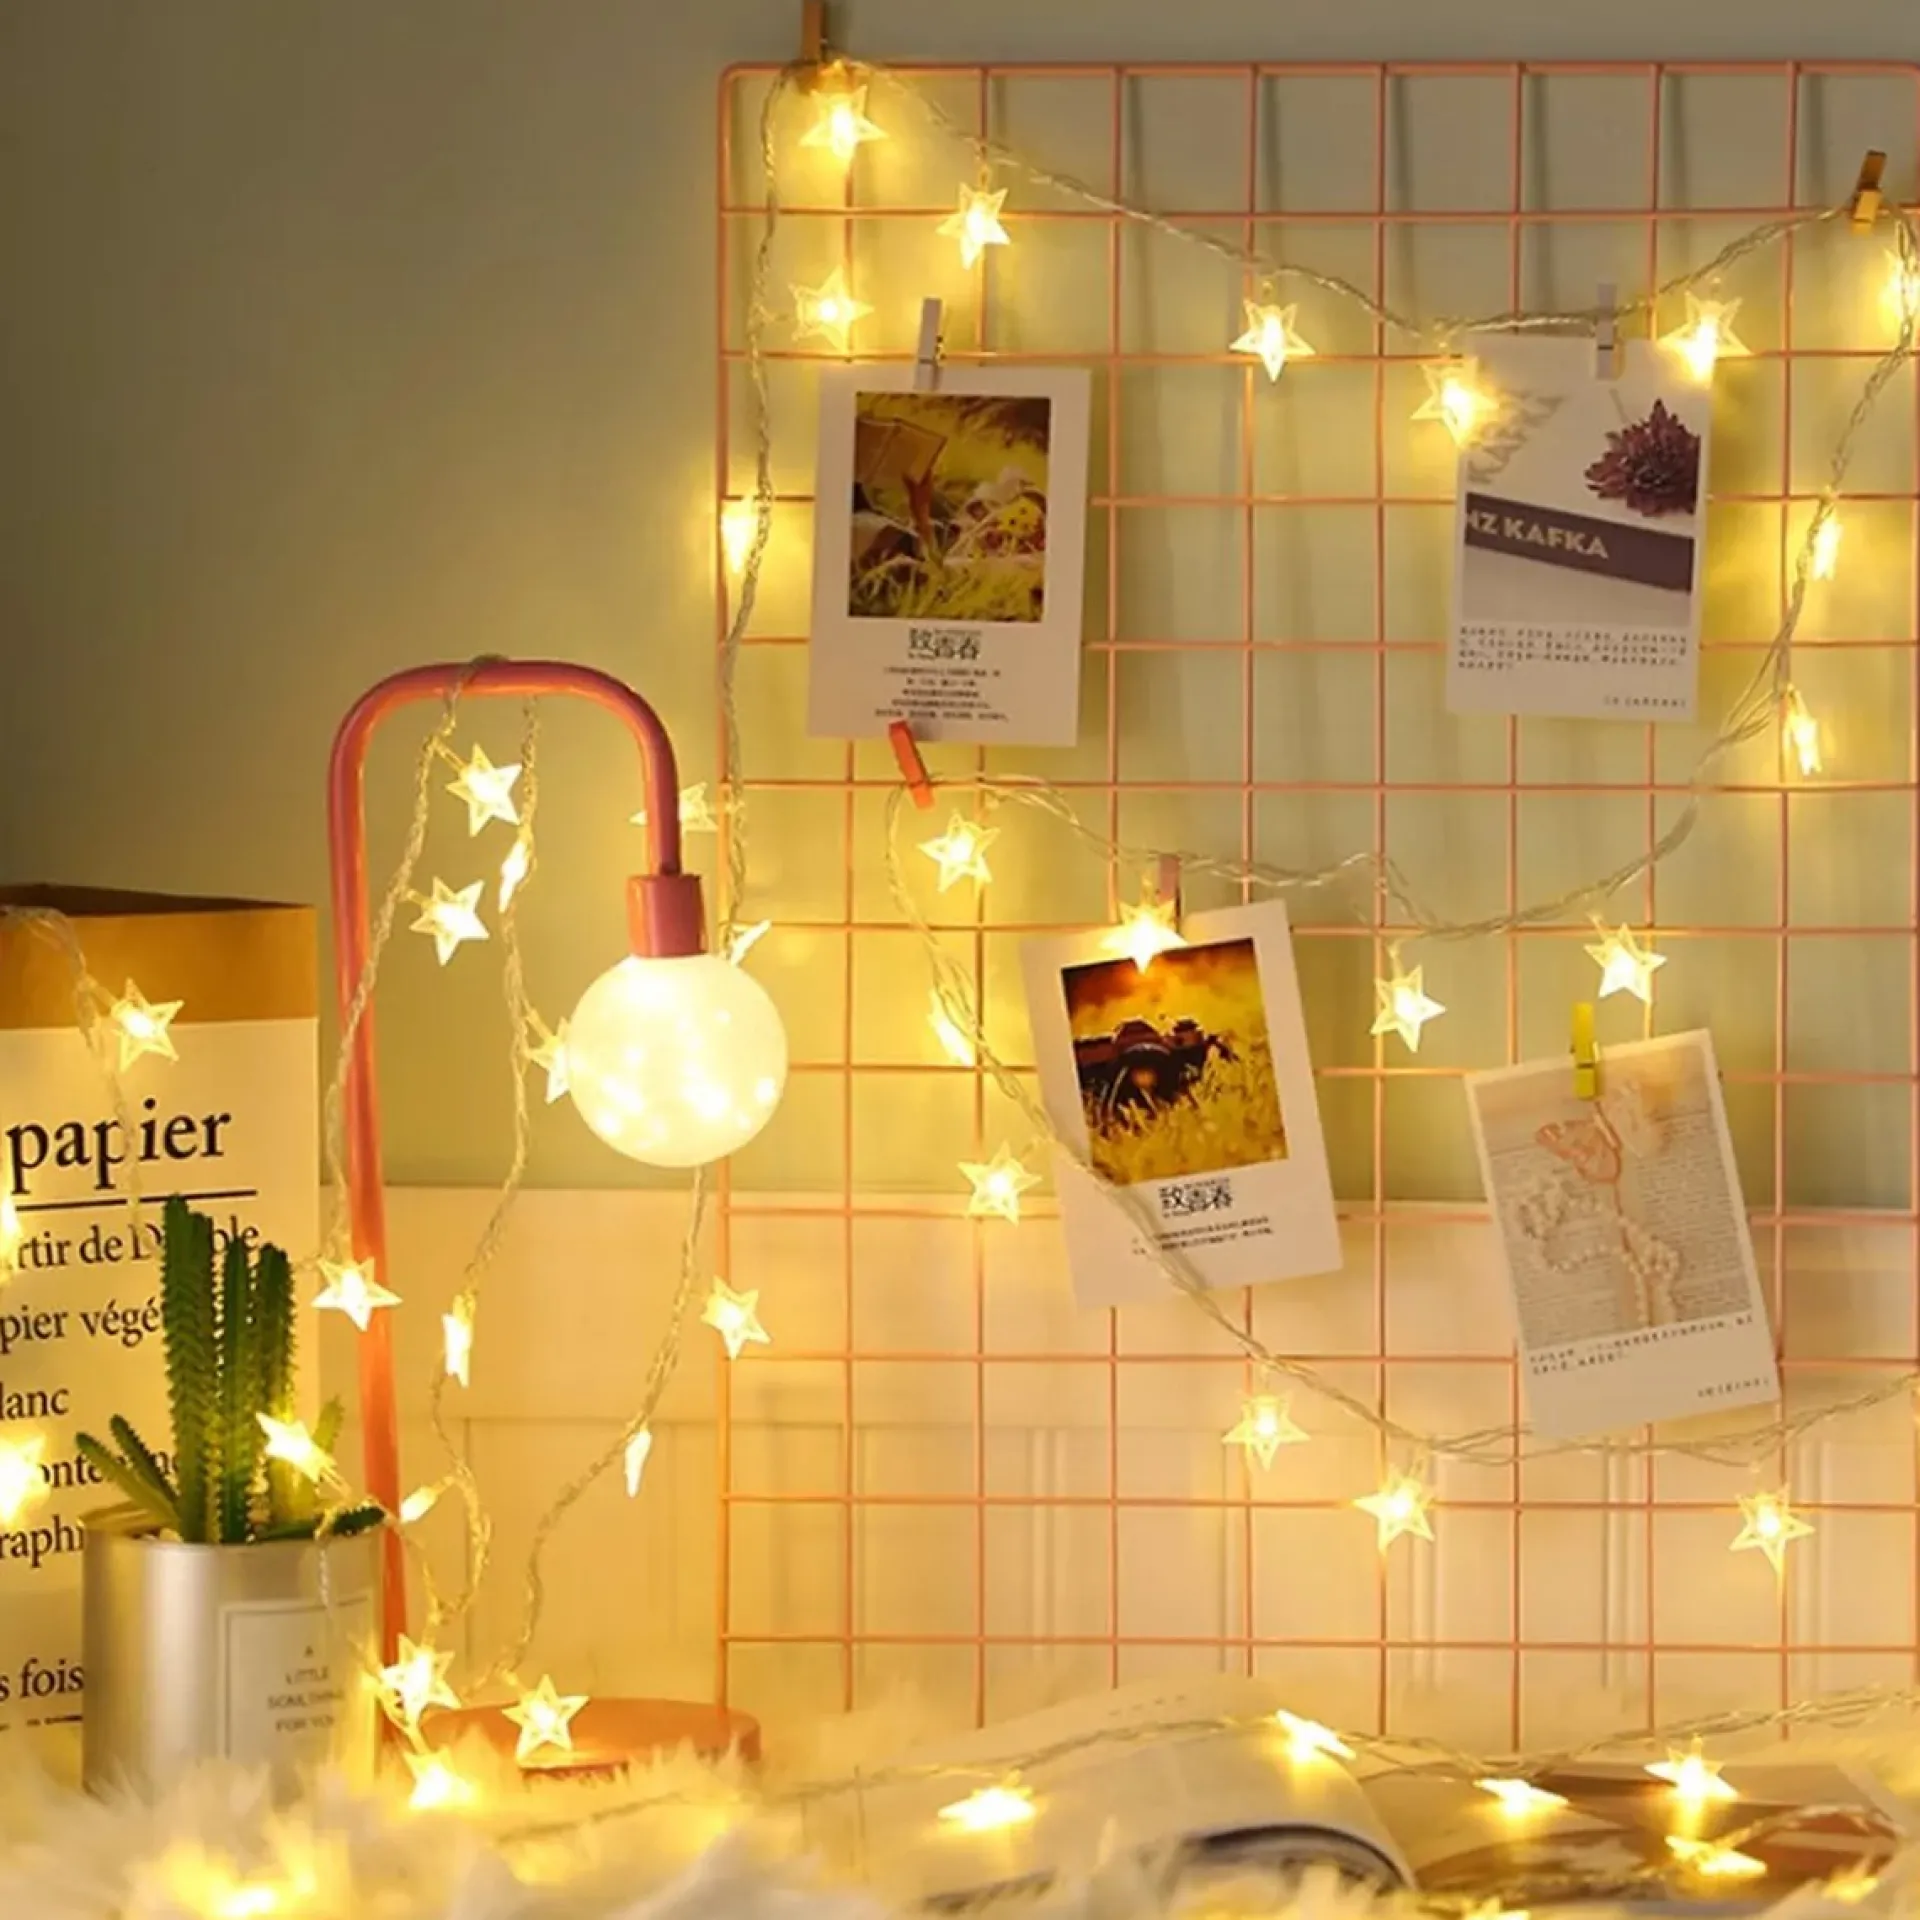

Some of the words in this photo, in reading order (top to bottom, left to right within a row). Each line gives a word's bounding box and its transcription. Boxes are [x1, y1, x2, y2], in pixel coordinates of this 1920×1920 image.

[1503, 516, 1609, 559] KAFKA
[6, 1098, 232, 1195] papier
[17, 1230, 72, 1269] rtir
[79, 1224, 124, 1264] de
[79, 1297, 160, 1348] végé
[20, 1656, 85, 1698] fois
